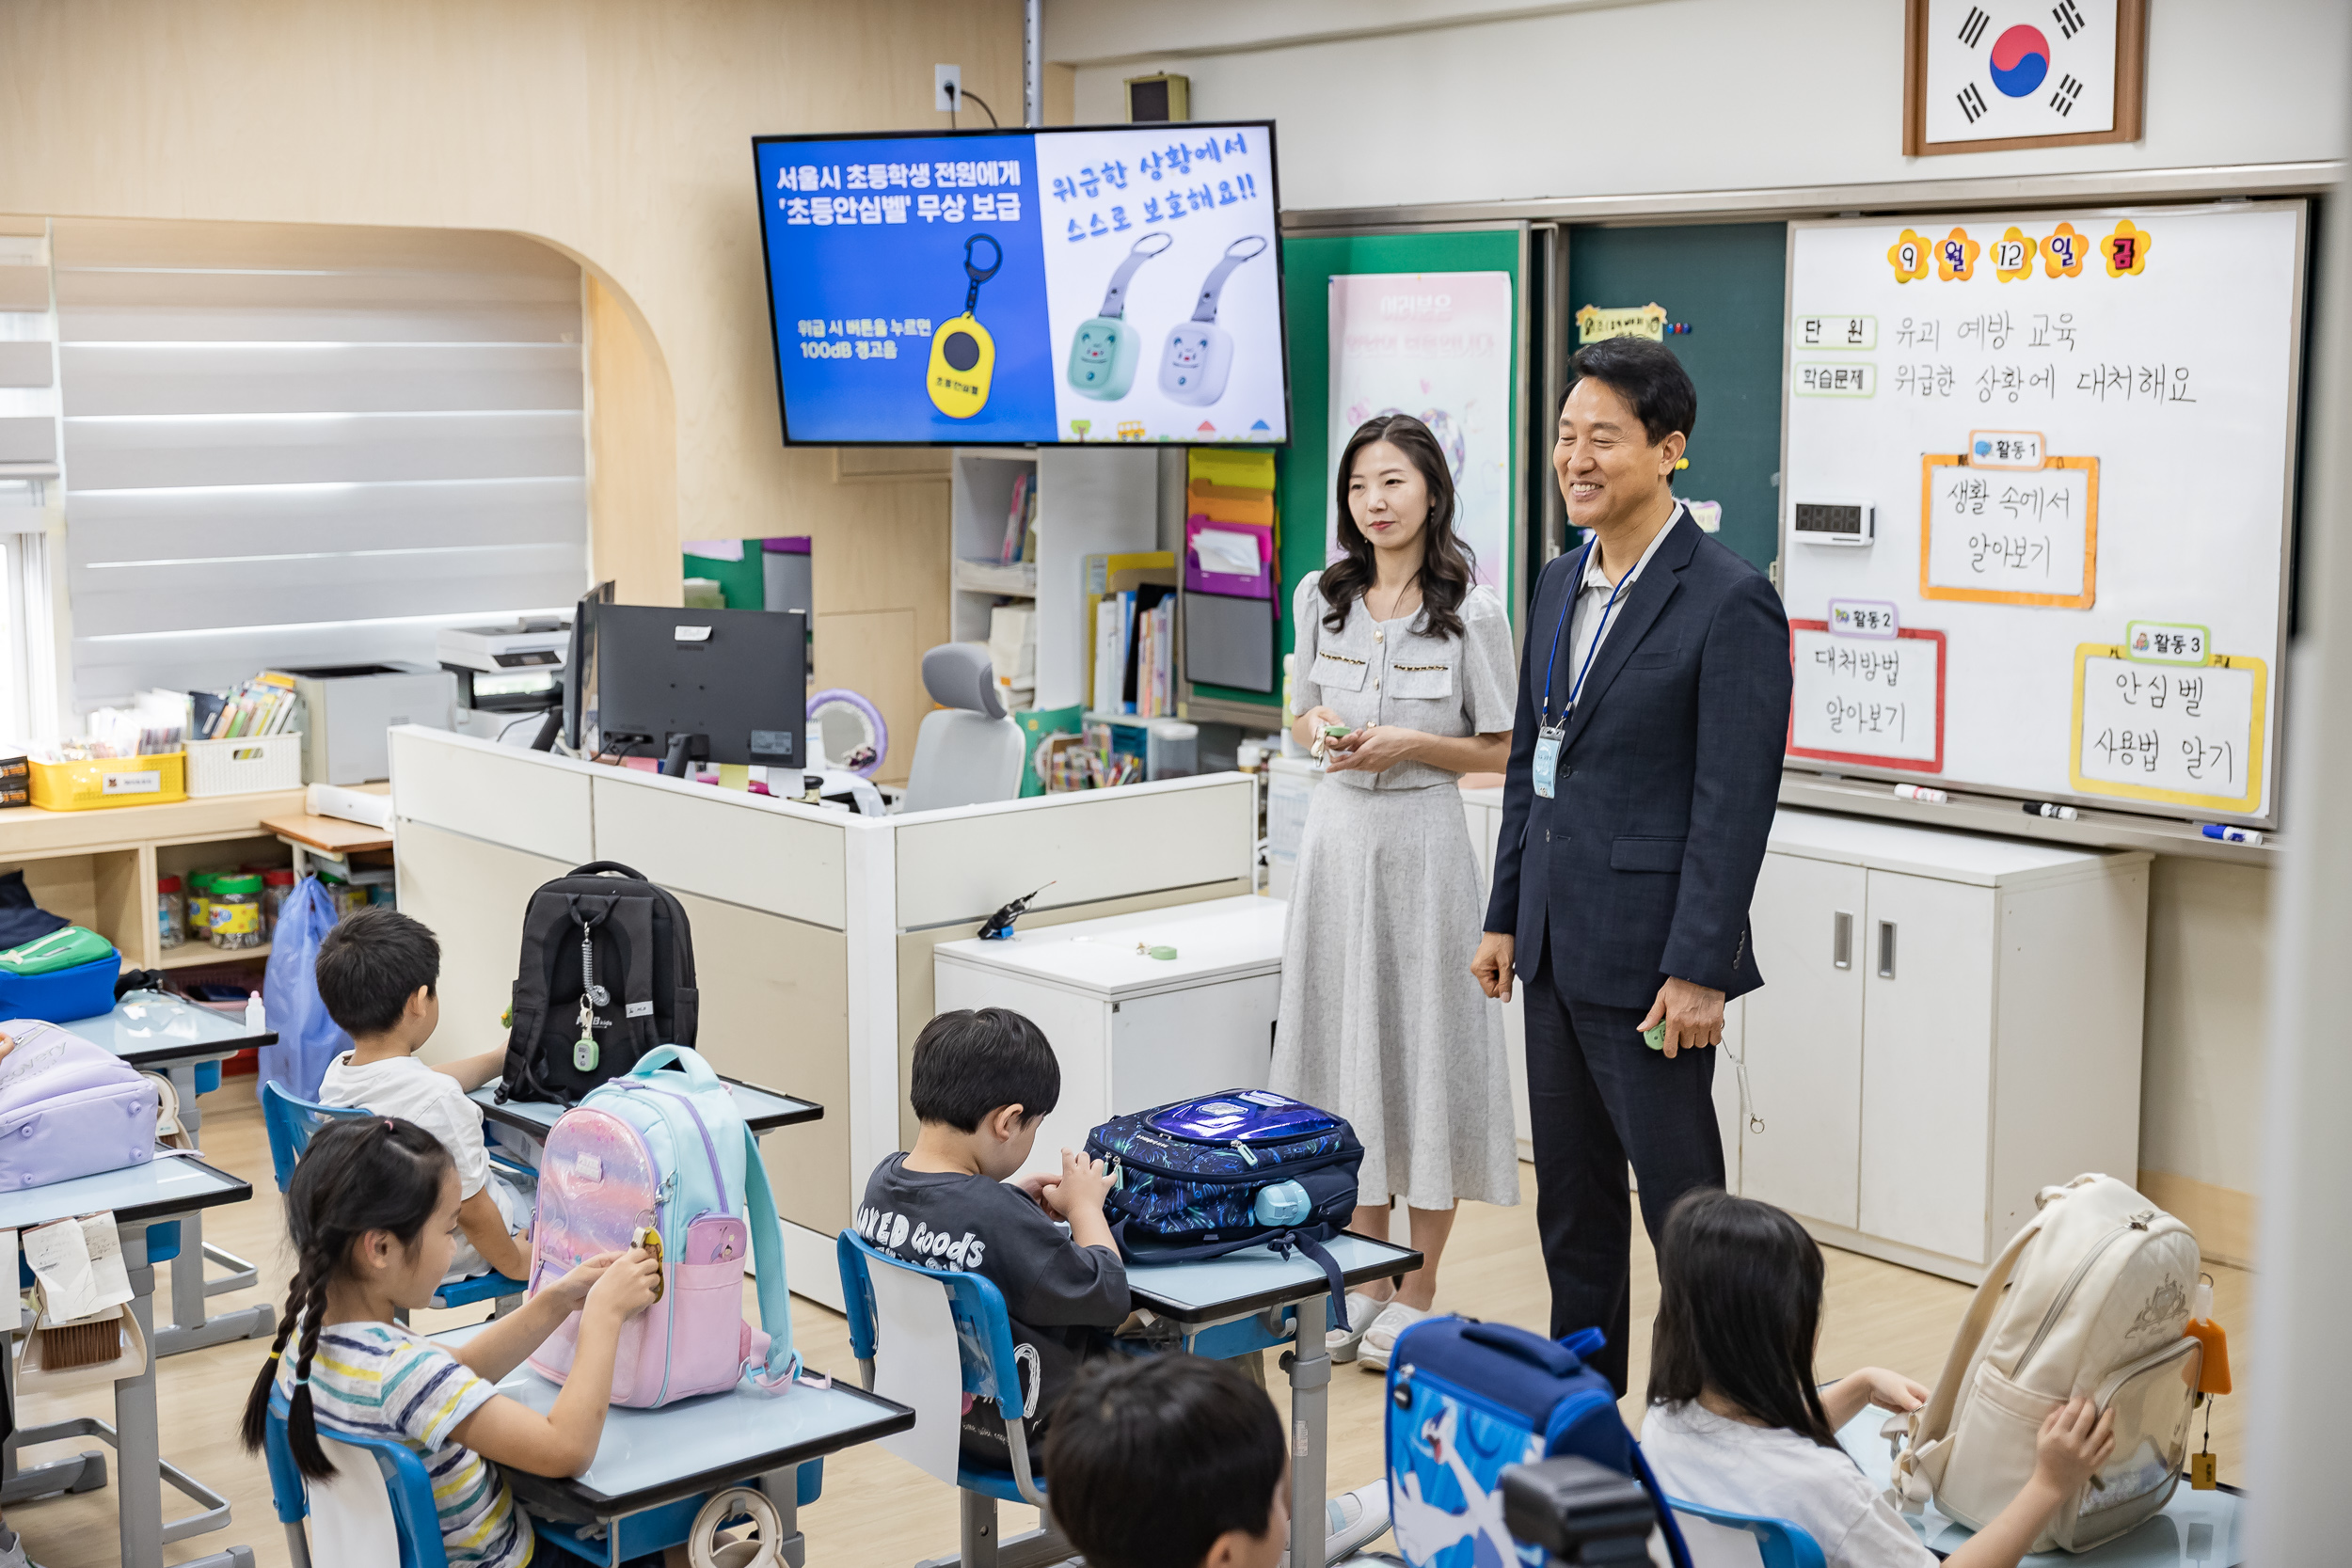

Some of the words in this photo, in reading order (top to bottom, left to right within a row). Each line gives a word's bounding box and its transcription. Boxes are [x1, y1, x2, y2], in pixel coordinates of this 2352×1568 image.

[777, 165, 841, 192] 서울시
[846, 162, 930, 189] 초등학생
[934, 160, 1021, 187] 전원에게
[1052, 160, 1128, 203] 위급한
[1140, 134, 1247, 182] 상황에서
[779, 195, 910, 225] '초등안심벨'
[916, 194, 967, 224] 무상
[971, 193, 1021, 222] 보급
[1066, 204, 1133, 243] 스스로
[1143, 174, 1257, 224] 보호해요!!
[1902, 246, 1915, 270] 9
[1945, 241, 1964, 272] 월
[1997, 244, 2022, 268] 12
[2051, 237, 2074, 268] 일
[2112, 238, 2137, 271] 금
[798, 319, 826, 337] 위급
[829, 319, 843, 337] 시
[847, 319, 888, 337] 버튼을
[891, 319, 931, 337] 누르면
[1896, 317, 1940, 353] 유괴
[1957, 309, 2014, 352] 예방
[2026, 311, 2078, 352] 교육
[801, 341, 851, 359] 100dB
[855, 341, 898, 359] 경고음
[1803, 368, 1865, 391] 학습문제
[1895, 364, 1955, 398] 위급한
[1975, 365, 2056, 404] 상황에
[2076, 363, 2197, 404] 대처해요
[1947, 478, 1989, 515] 생활
[1999, 485, 2071, 522] 속에서
[1968, 532, 2051, 578] 알아보기
[1815, 644, 1899, 686] 대처방법
[1826, 695, 1906, 743] 알아보기
[2093, 727, 2159, 772] 사용법
[2182, 736, 2233, 784] 알기
[576, 1017, 600, 1025] MB
[911, 1222, 986, 1268] Goods
